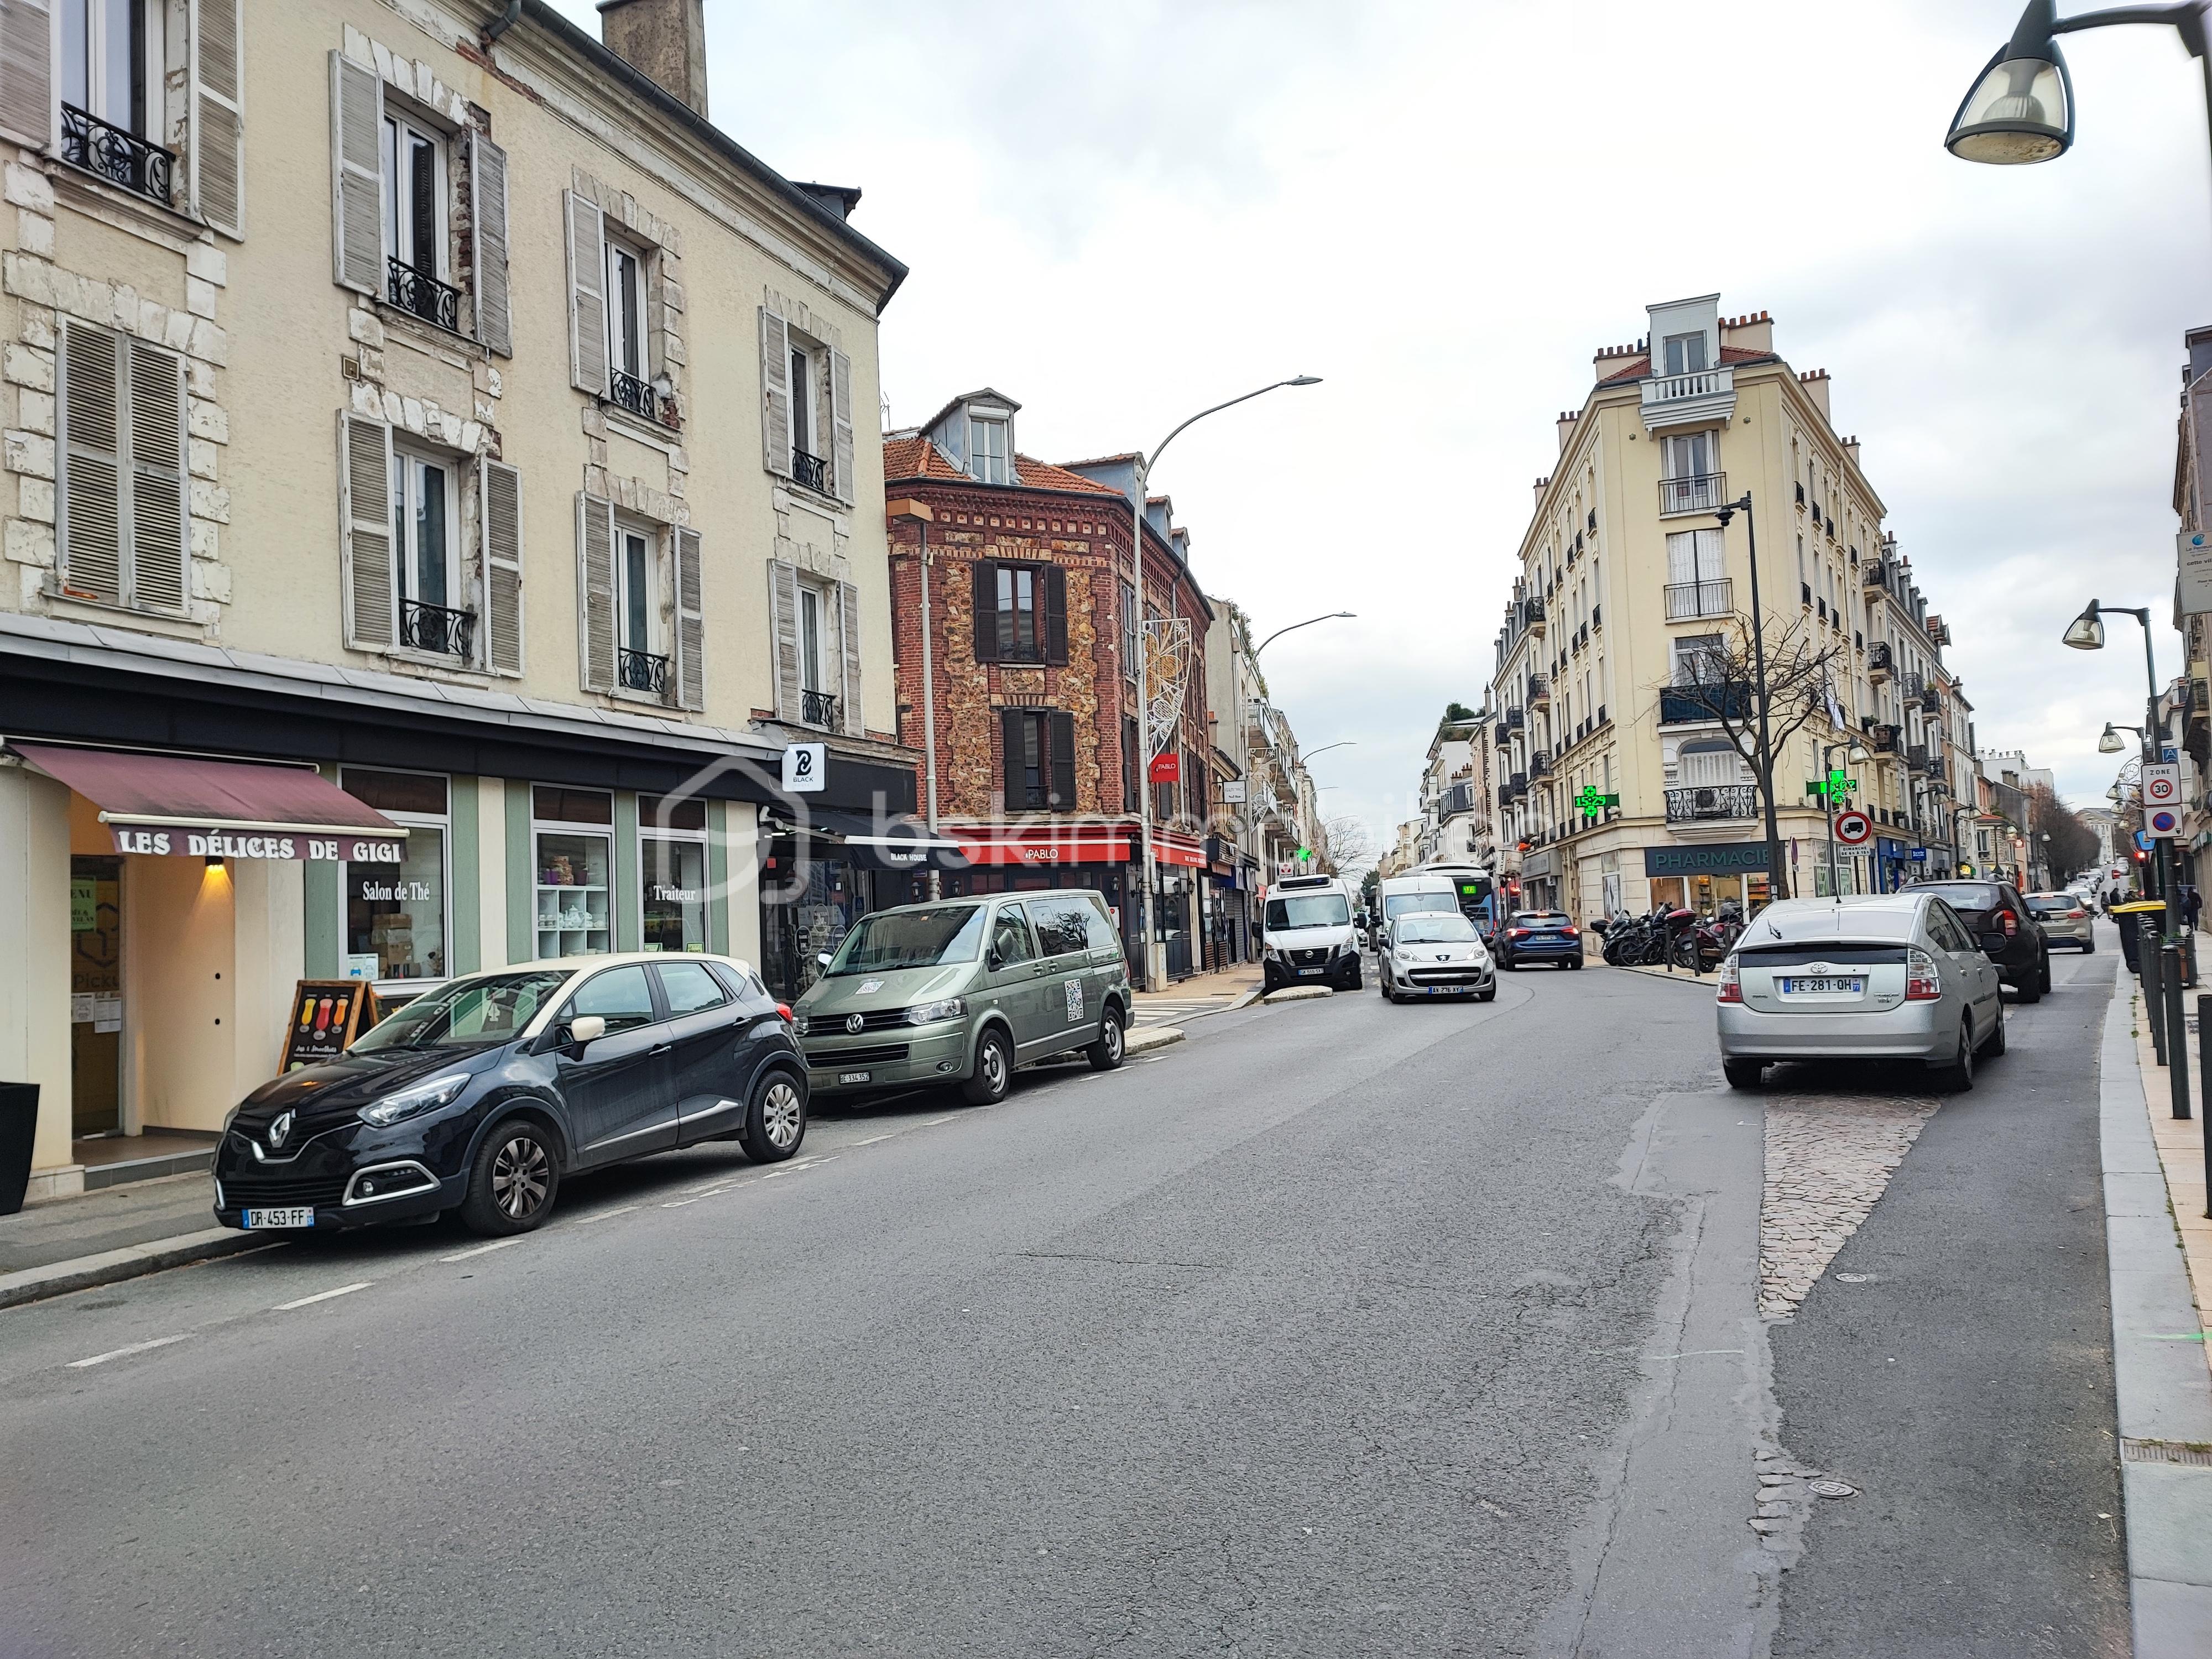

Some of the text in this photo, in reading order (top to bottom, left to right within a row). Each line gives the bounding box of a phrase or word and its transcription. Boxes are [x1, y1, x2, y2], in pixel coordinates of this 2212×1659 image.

[2155, 785, 2168, 793] 30
[1575, 796, 1606, 806] 15:29
[118, 829, 401, 863] LES DÉLICES DE GIGI
[363, 881, 430, 901] Salon de Thé
[653, 885, 696, 901] Traiteur
[1792, 979, 1851, 992] FE-281-QH
